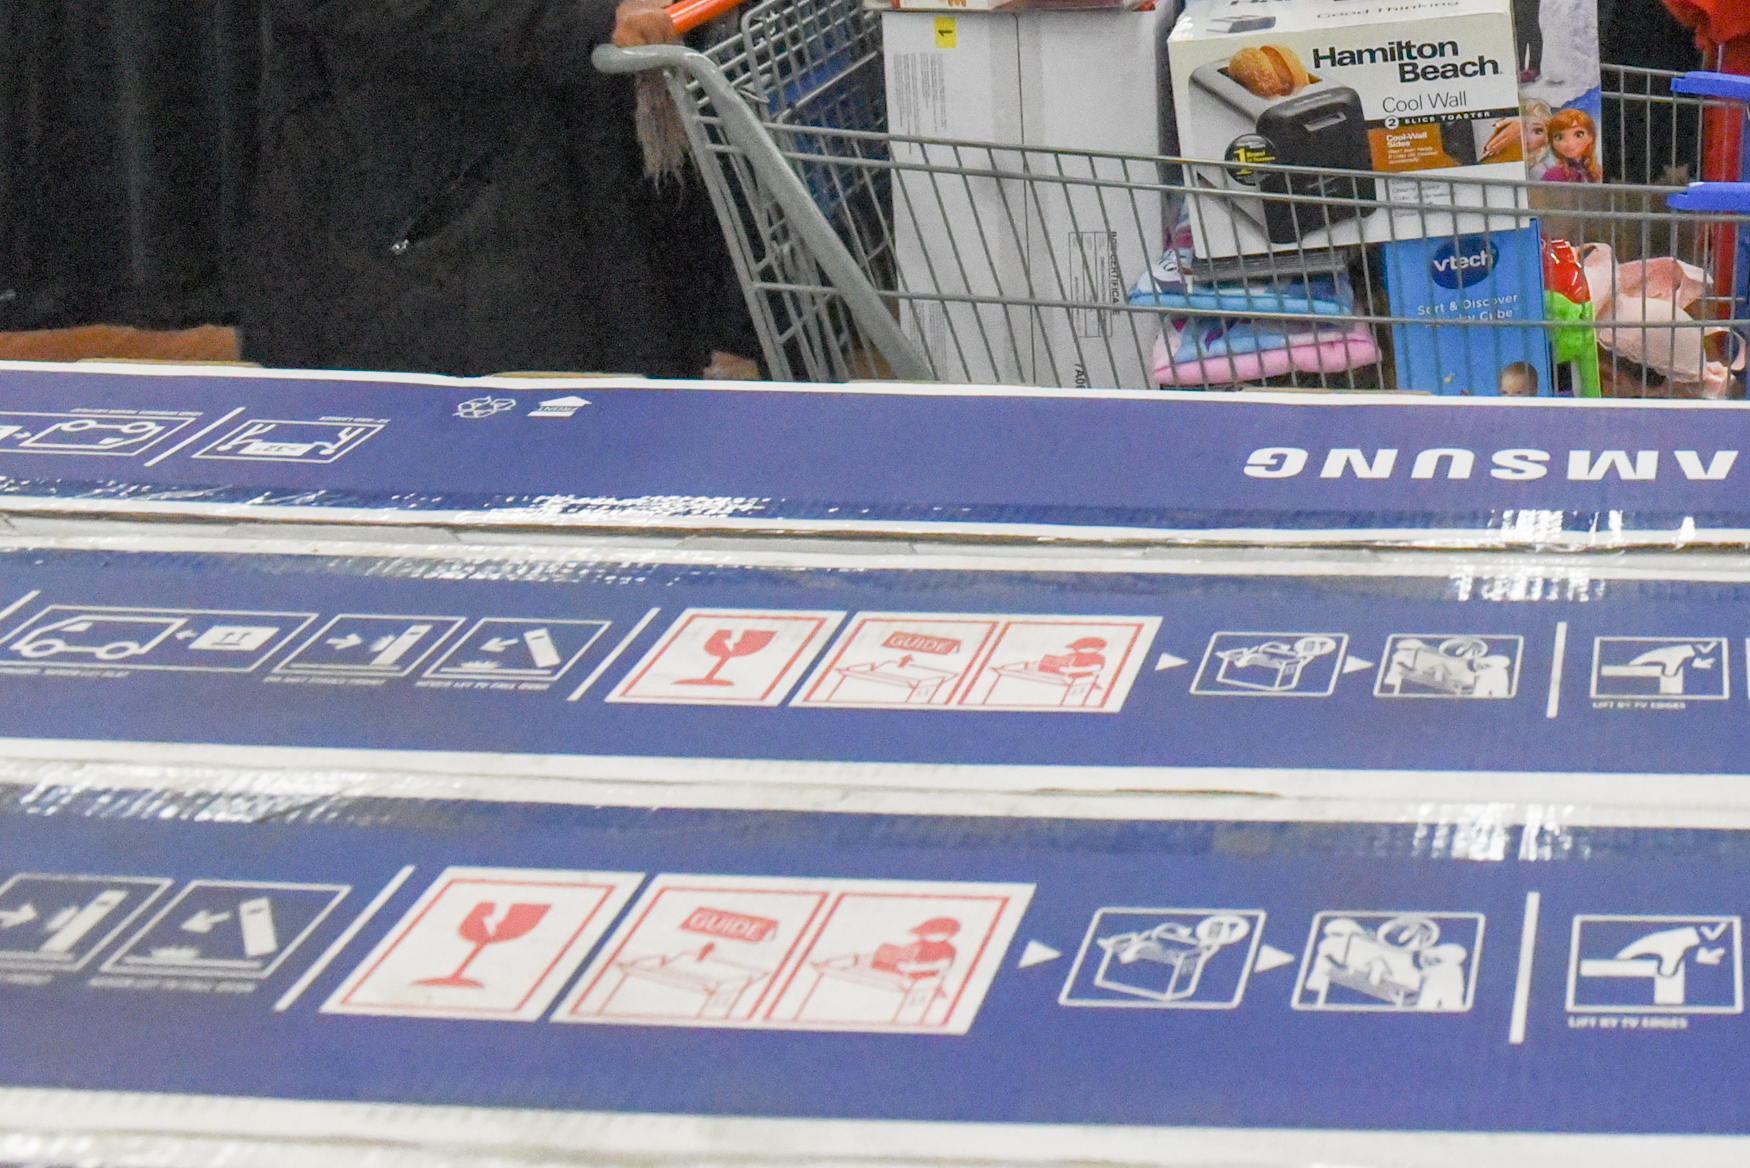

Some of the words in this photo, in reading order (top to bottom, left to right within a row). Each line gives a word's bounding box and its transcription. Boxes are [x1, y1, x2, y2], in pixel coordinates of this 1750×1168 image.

[1312, 39, 1459, 69] Hamilton
[1399, 55, 1499, 83] Beach
[1382, 94, 1423, 114] Cool
[1427, 90, 1468, 109] Wall
[1404, 116, 1436, 125] SLICE
[1441, 111, 1491, 122] TOASTER
[1433, 250, 1494, 272] vtech
[1450, 301, 1459, 311] &
[888, 635, 947, 651] GUIDE
[689, 912, 762, 936] GUIDE
